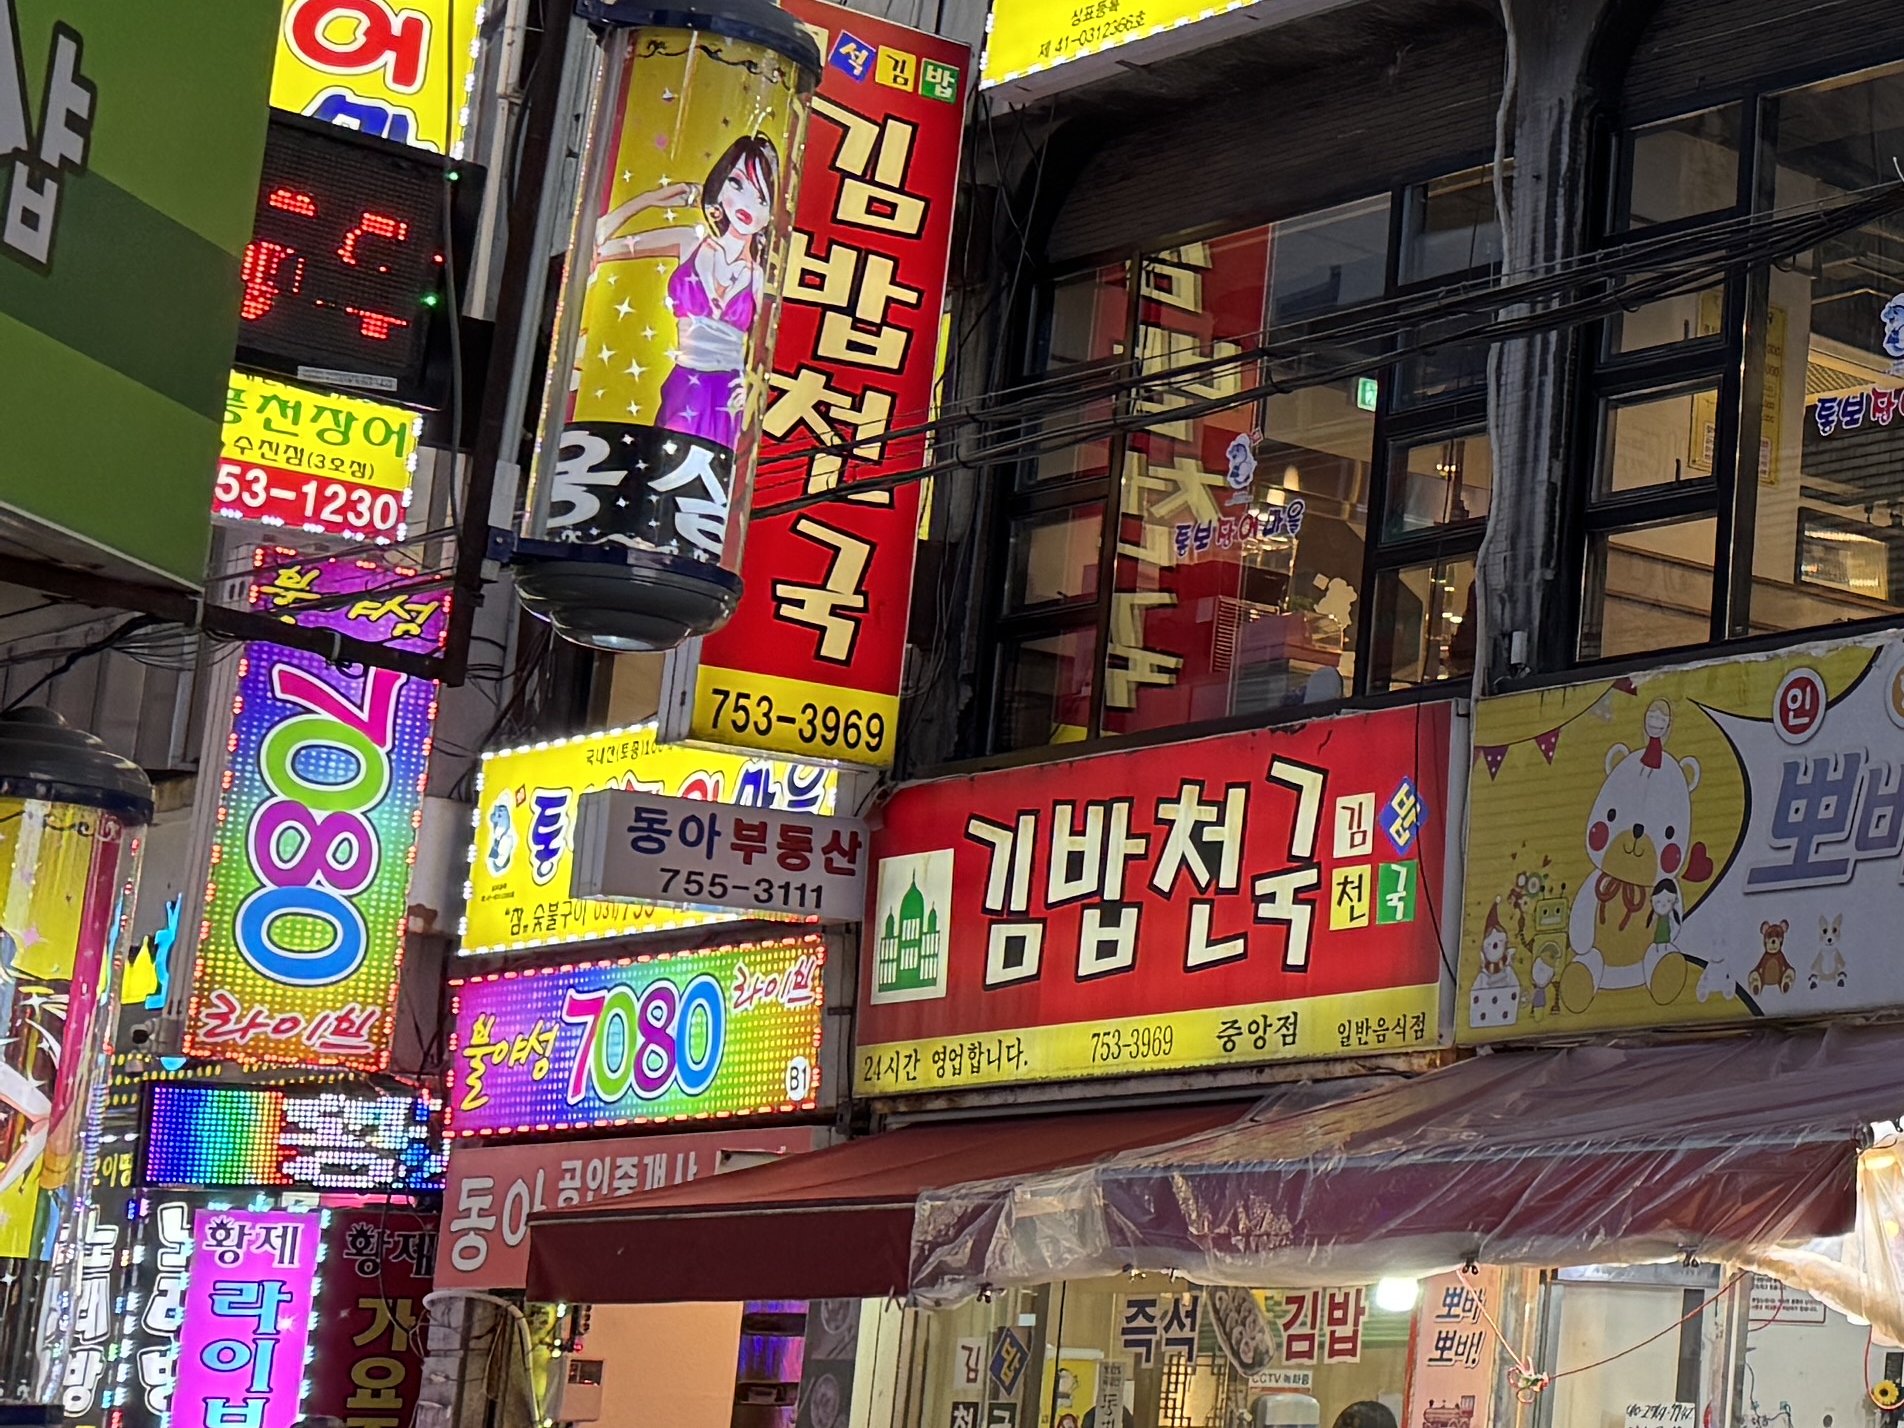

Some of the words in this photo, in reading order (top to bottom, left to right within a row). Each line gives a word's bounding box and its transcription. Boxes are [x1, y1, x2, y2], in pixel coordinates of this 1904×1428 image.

[763, 95, 928, 666] 김밥천국
[214, 462, 399, 531] 53-1230
[709, 686, 886, 753] 753-3969
[234, 659, 408, 988] 7080
[659, 867, 824, 910] 755-3111
[965, 755, 1329, 992] 김밥천국
[200, 990, 381, 1054] 라이브
[460, 1011, 560, 1112] 불야성
[560, 972, 727, 1107] 7080
[863, 1047, 921, 1086] 24시간
[930, 1036, 1029, 1081] 영업합니다.
[1090, 1024, 1175, 1064] 753-3969
[1215, 1010, 1300, 1055] 중앙점
[1336, 1010, 1427, 1050] 일반음식점
[203, 1215, 304, 1270] 황제
[1120, 1296, 1200, 1365] 즉석
[1280, 1286, 1367, 1364] 김밥
